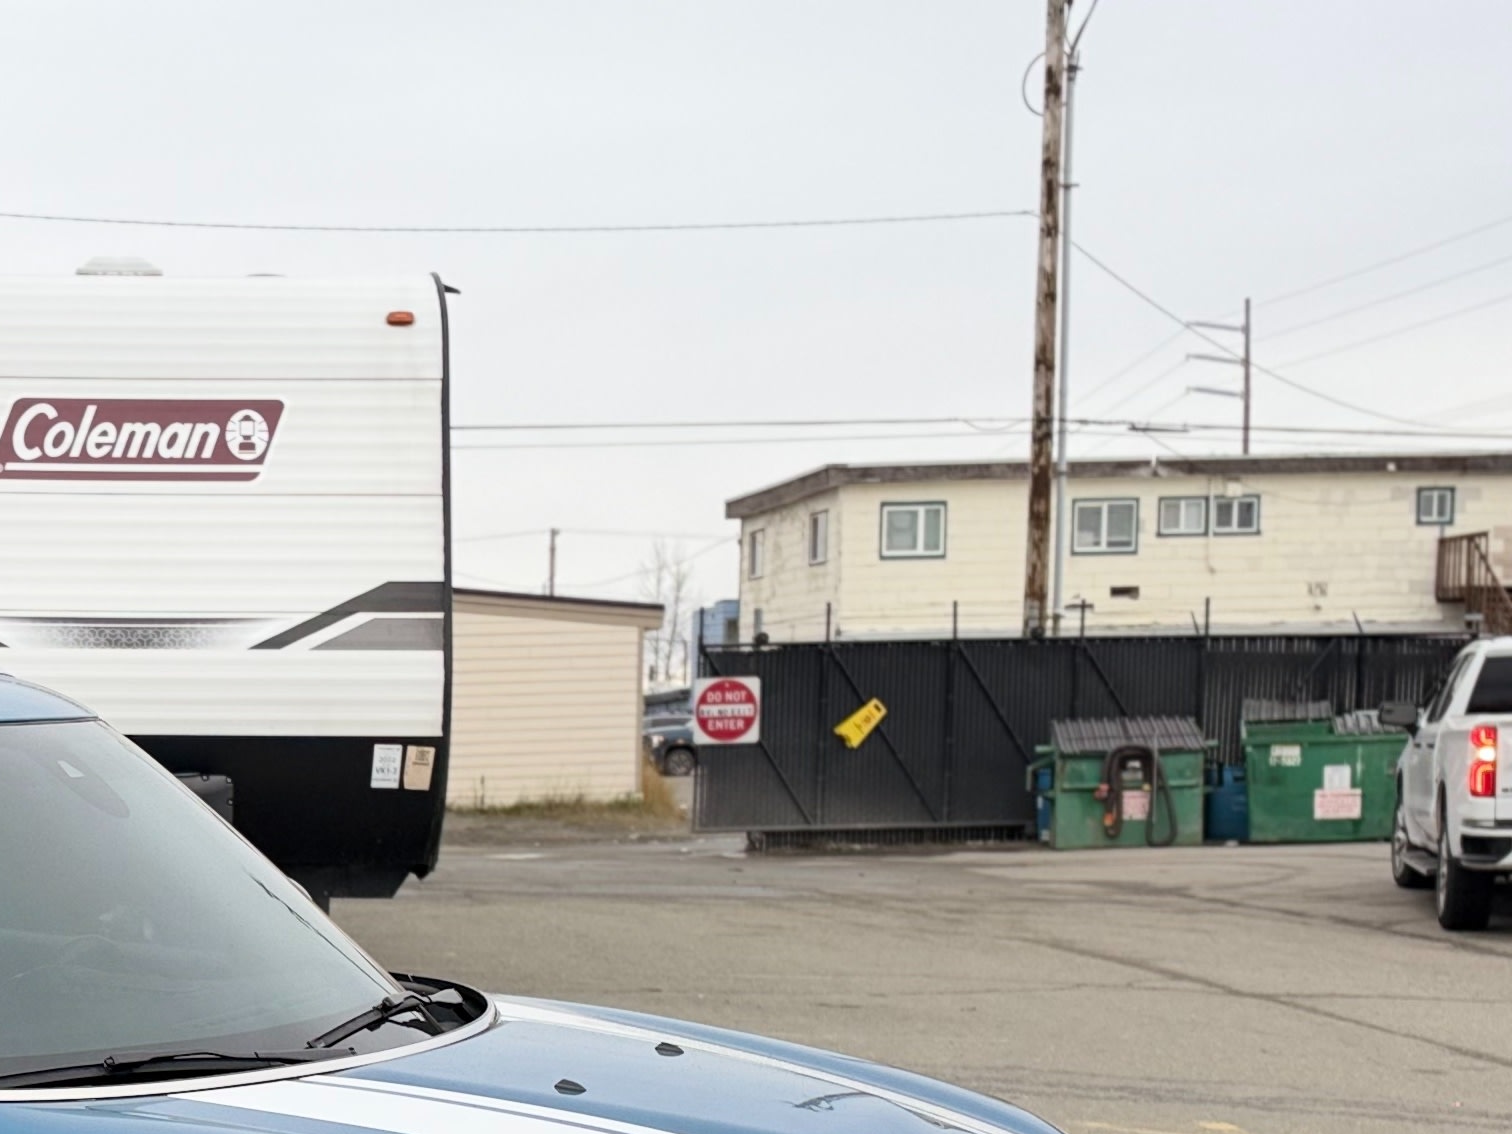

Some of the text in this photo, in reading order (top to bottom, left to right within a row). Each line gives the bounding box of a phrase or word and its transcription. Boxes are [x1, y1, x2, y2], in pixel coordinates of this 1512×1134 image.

[12, 402, 221, 461] Coleman
[706, 690, 747, 703] DO NOT
[708, 718, 745, 731] ENTER
